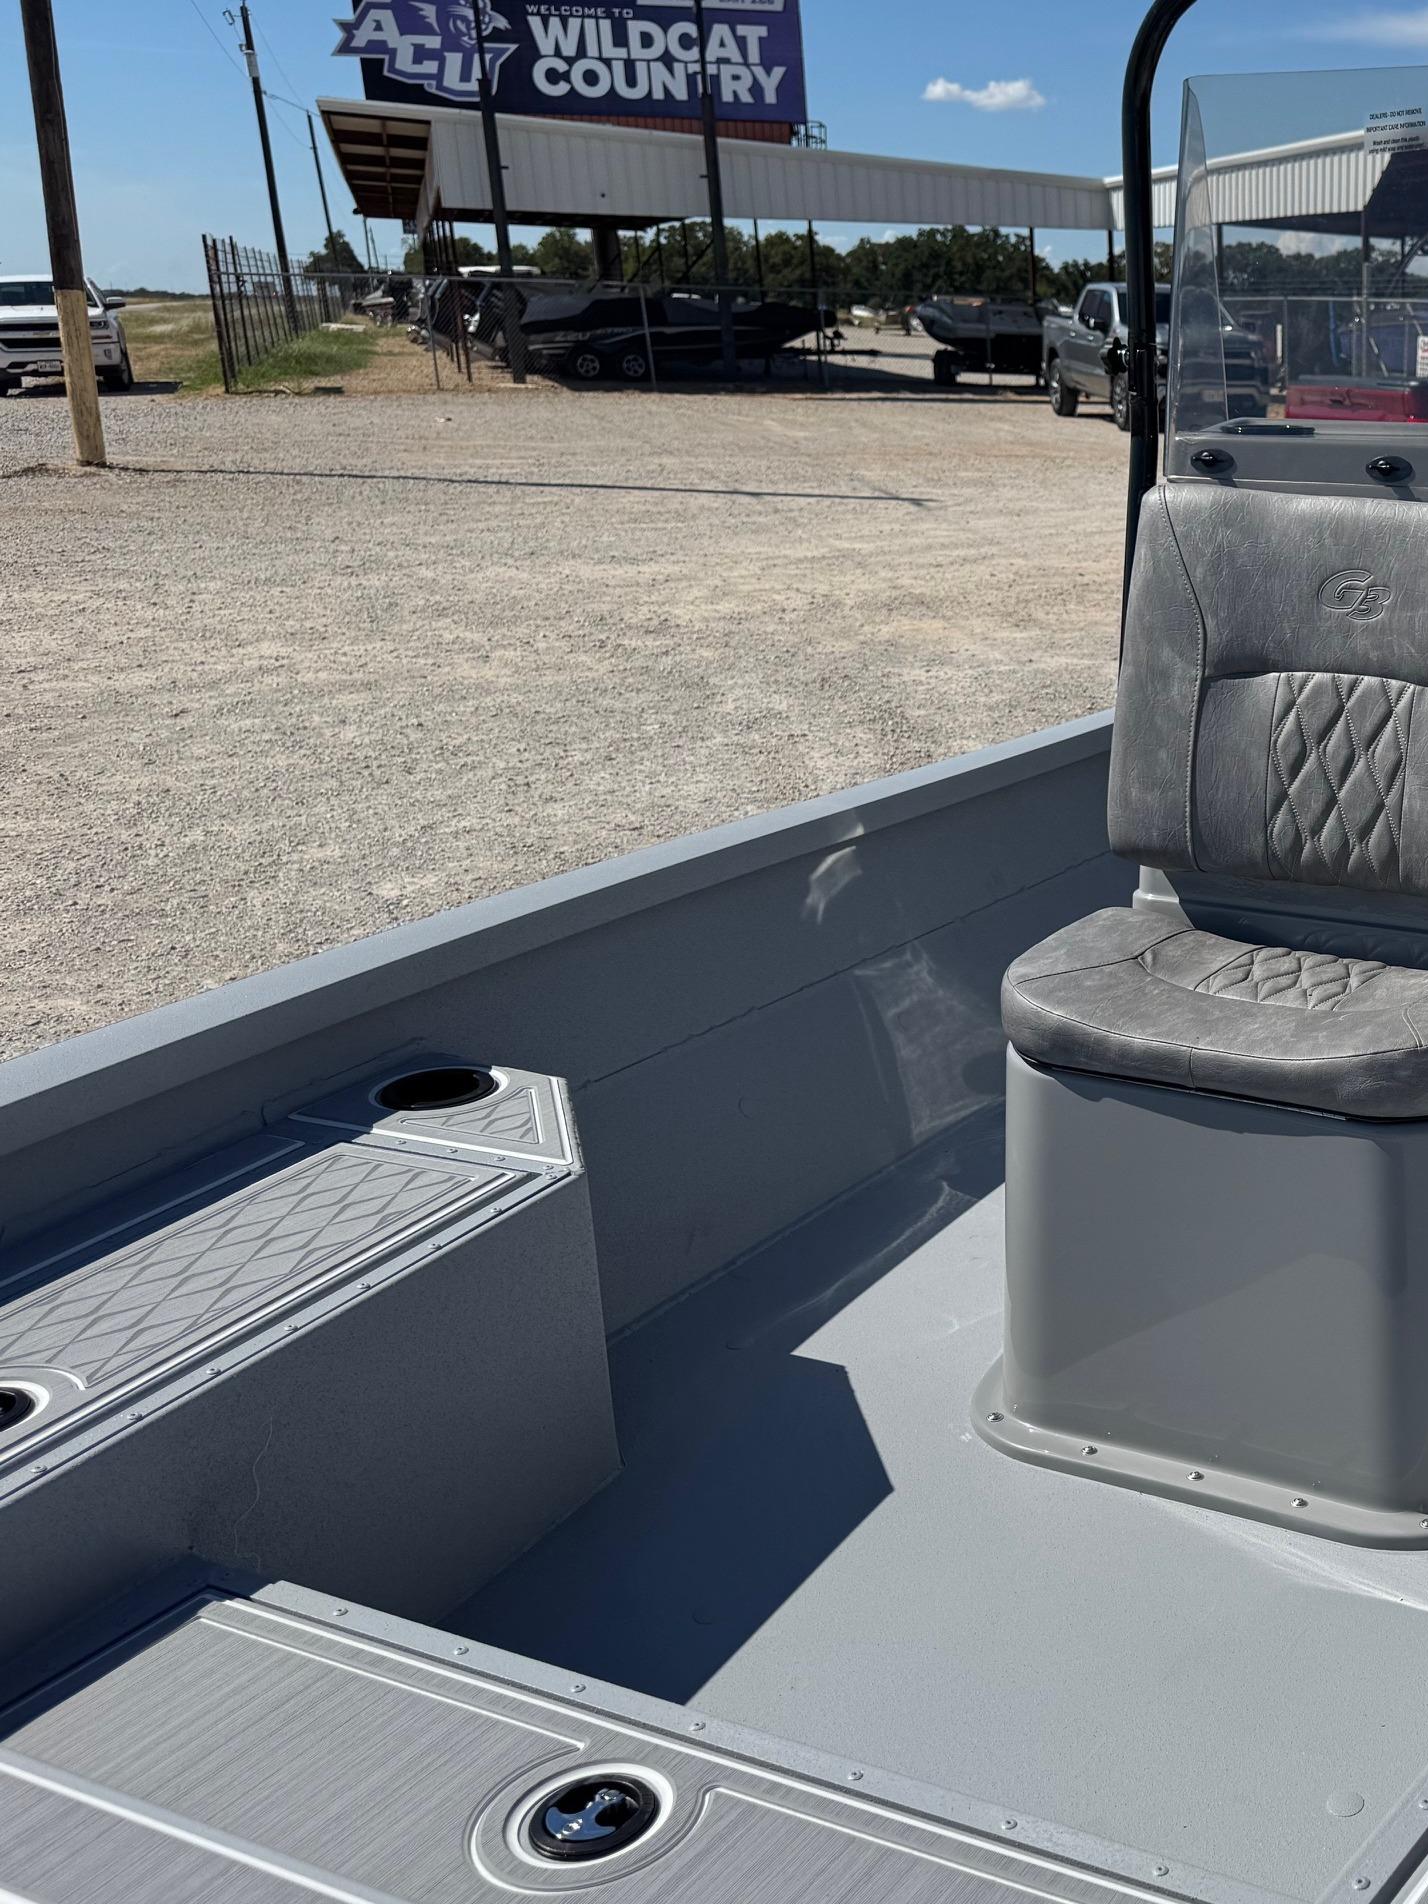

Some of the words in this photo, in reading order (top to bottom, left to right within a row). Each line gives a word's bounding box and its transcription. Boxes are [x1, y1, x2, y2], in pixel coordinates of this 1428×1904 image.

[526, 4, 606, 17] WELCOME
[613, 8, 634, 18] TO
[349, 9, 493, 91] ACU
[527, 15, 768, 64] WILDCAT
[532, 57, 787, 104] COUNTRY
